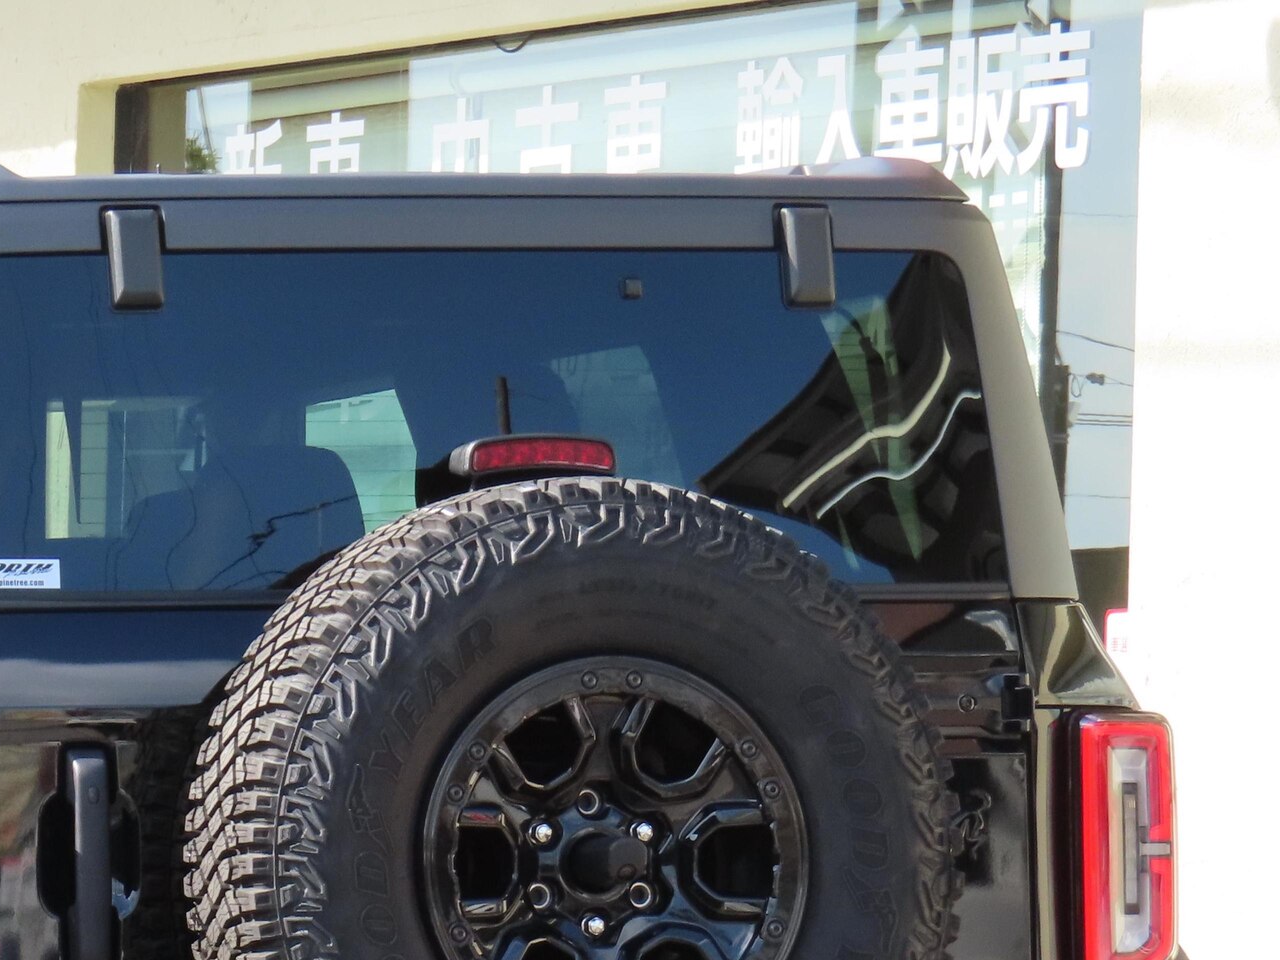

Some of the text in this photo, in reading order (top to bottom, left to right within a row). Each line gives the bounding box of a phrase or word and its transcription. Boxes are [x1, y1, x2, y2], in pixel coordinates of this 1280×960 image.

[433, 74, 667, 174] 中古車
[735, 22, 1092, 179] 輸入車販売
